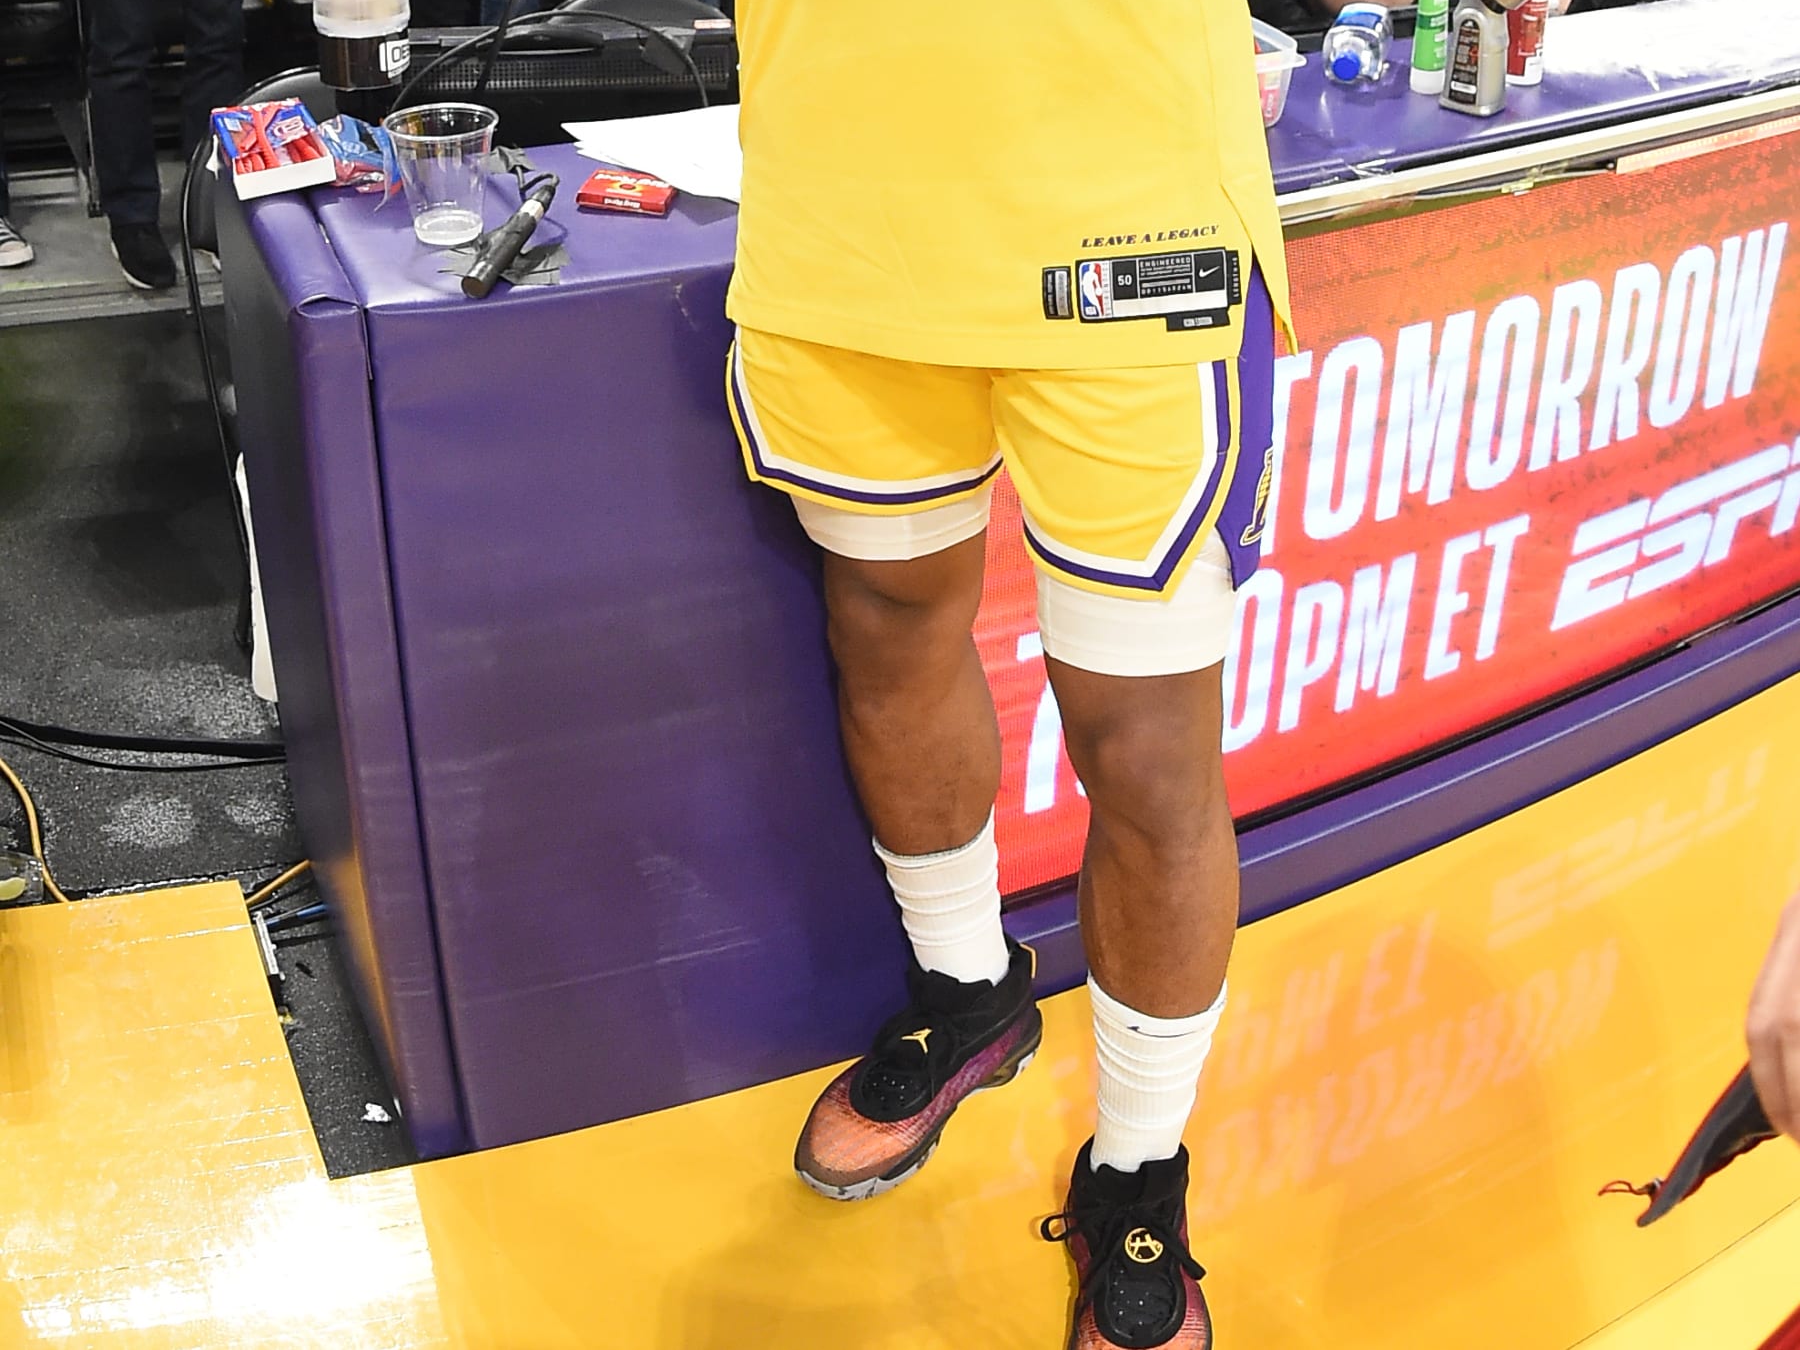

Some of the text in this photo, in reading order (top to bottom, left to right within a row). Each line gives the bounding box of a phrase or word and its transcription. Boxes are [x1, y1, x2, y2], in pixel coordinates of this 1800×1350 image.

[1081, 225, 1219, 248] LEAVE A LEGACY
[1117, 274, 1133, 286] 50
[1259, 222, 1788, 557] TOMORROW
[1423, 514, 1531, 682] ET
